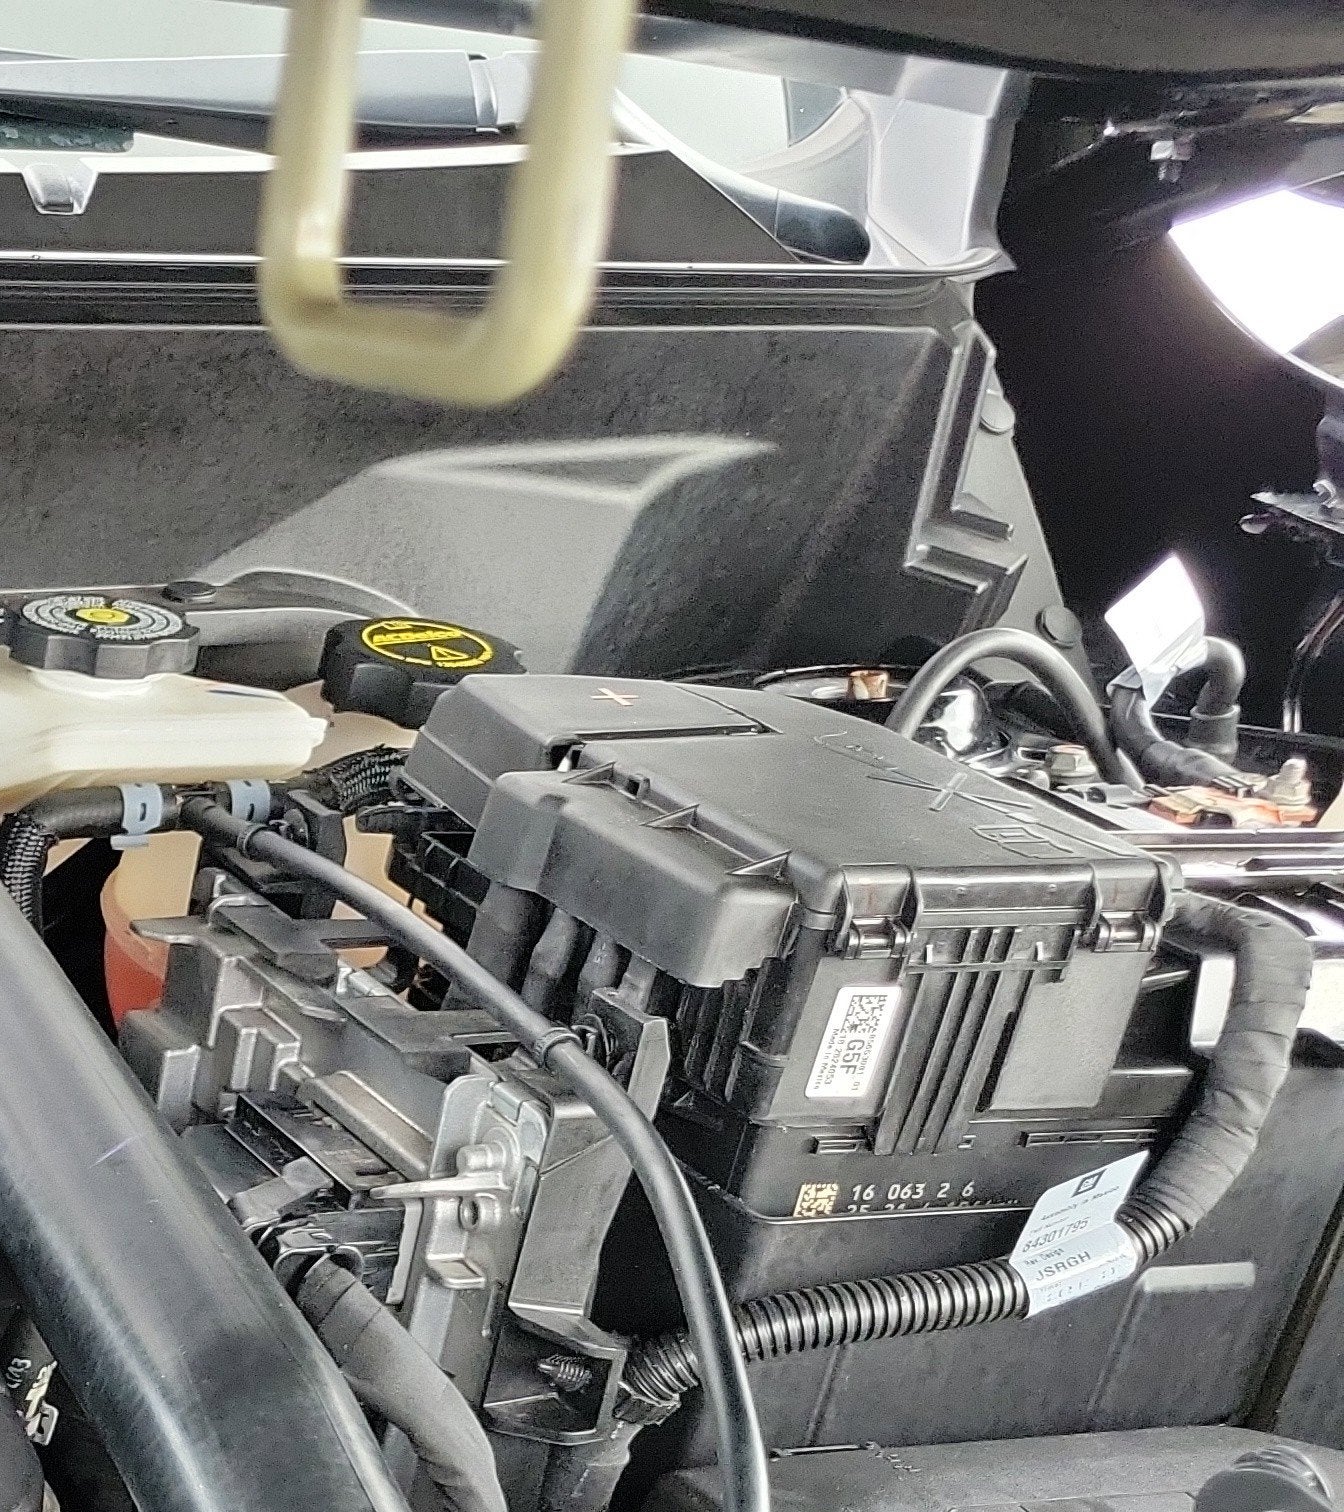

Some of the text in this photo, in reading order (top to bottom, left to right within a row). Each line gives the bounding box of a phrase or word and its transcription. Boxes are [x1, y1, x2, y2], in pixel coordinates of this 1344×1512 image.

[840, 1039, 865, 1075] G5F
[852, 1180, 975, 1201] 16 063 2 6
[1036, 1251, 1091, 1281] JSRGH
